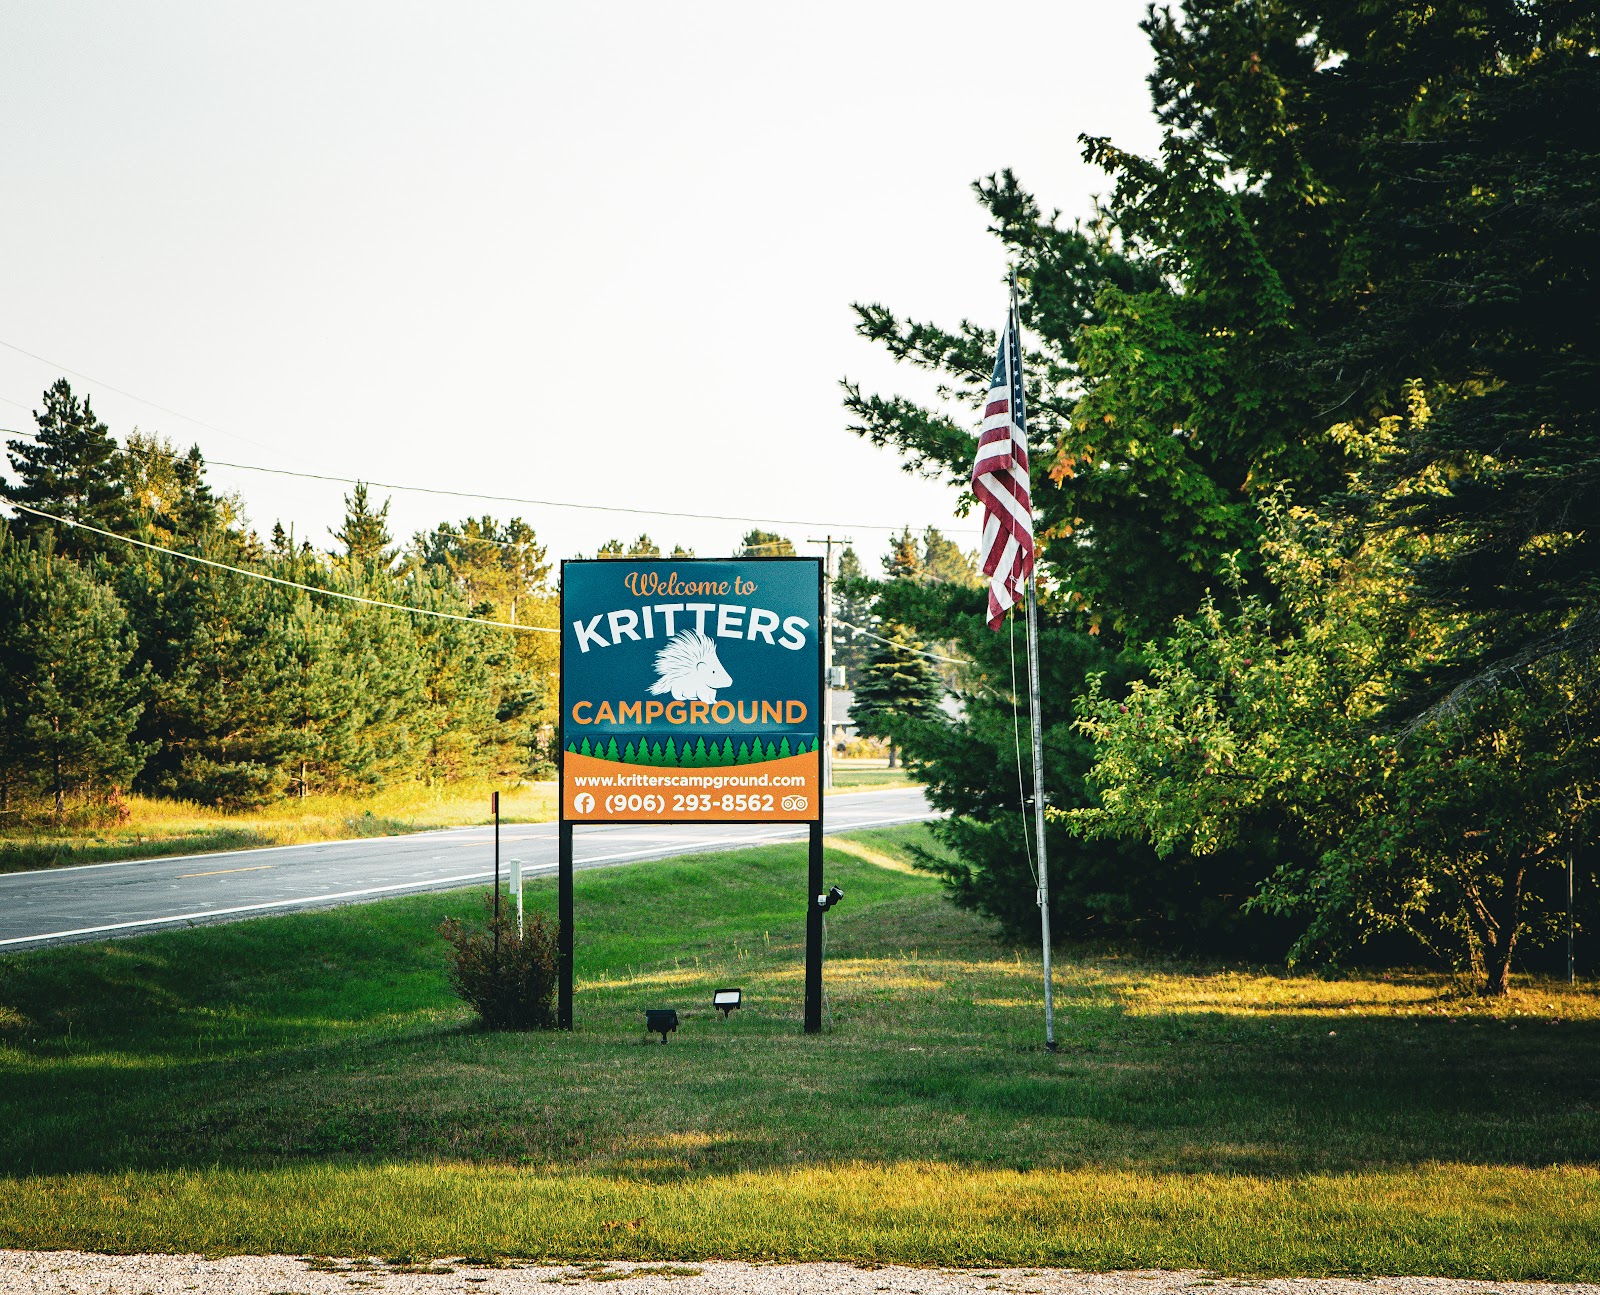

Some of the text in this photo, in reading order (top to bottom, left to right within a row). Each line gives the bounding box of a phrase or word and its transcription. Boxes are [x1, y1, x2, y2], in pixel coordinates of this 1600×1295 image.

[624, 572, 758, 597] Welcome to
[573, 603, 810, 654] KRITTERS
[572, 700, 808, 725] CAMPGROUND
[574, 774, 806, 789] www.kritterscampground.com
[605, 794, 666, 814] (906)
[672, 794, 775, 812] 293-8562
